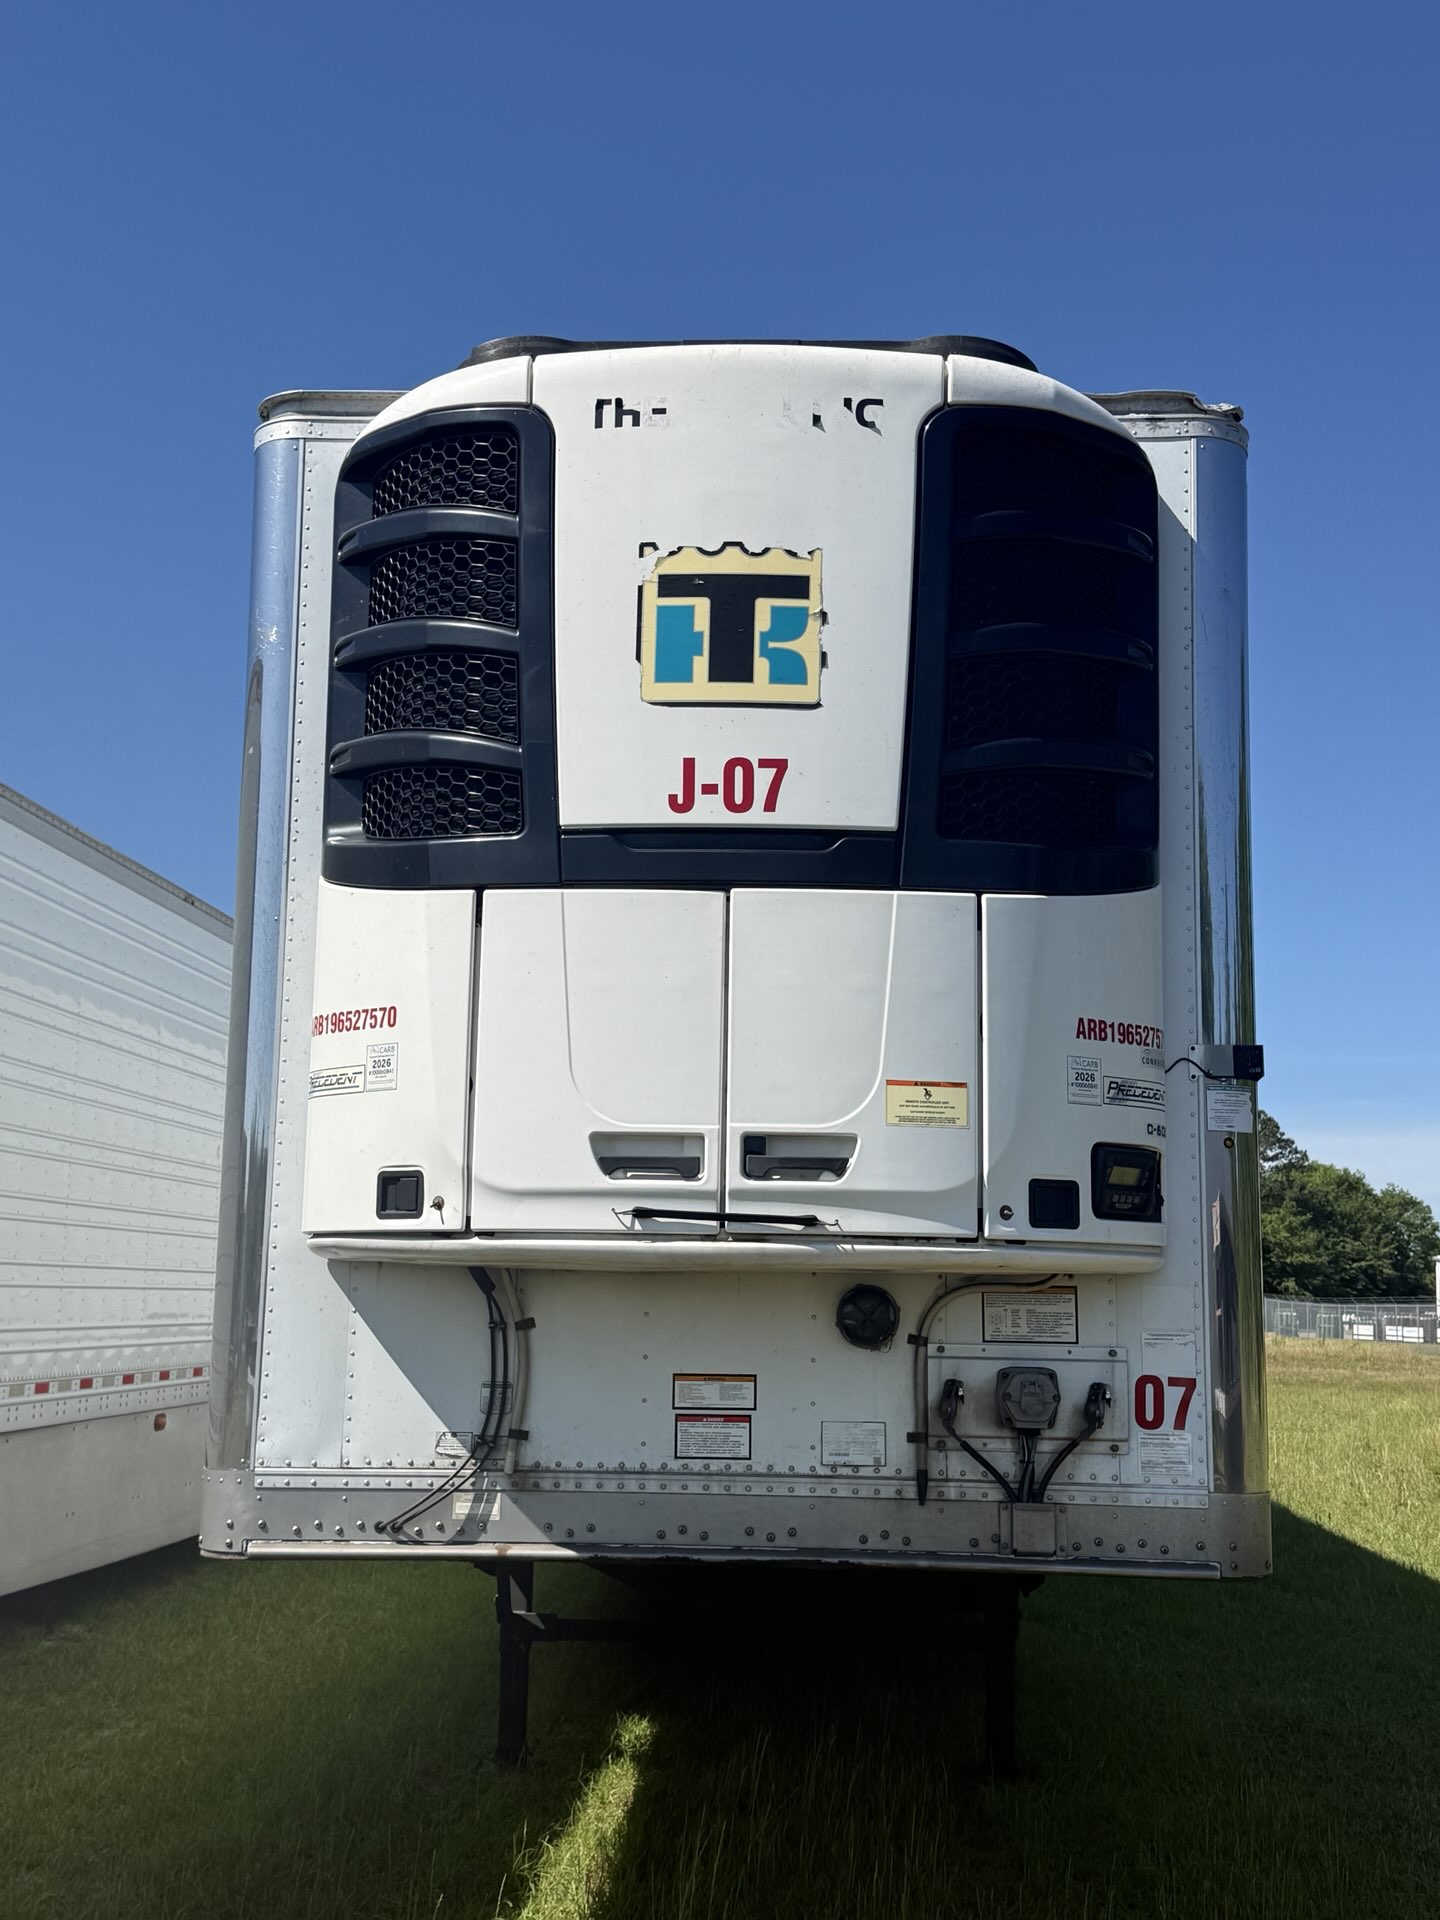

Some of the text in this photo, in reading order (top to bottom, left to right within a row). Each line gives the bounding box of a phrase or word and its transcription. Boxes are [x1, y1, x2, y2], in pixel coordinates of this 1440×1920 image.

[668, 757, 788, 814] J-07
[372, 1058, 392, 1069] 2026
[1075, 1072, 1096, 1083] 2026
[1135, 1374, 1197, 1431] 07
